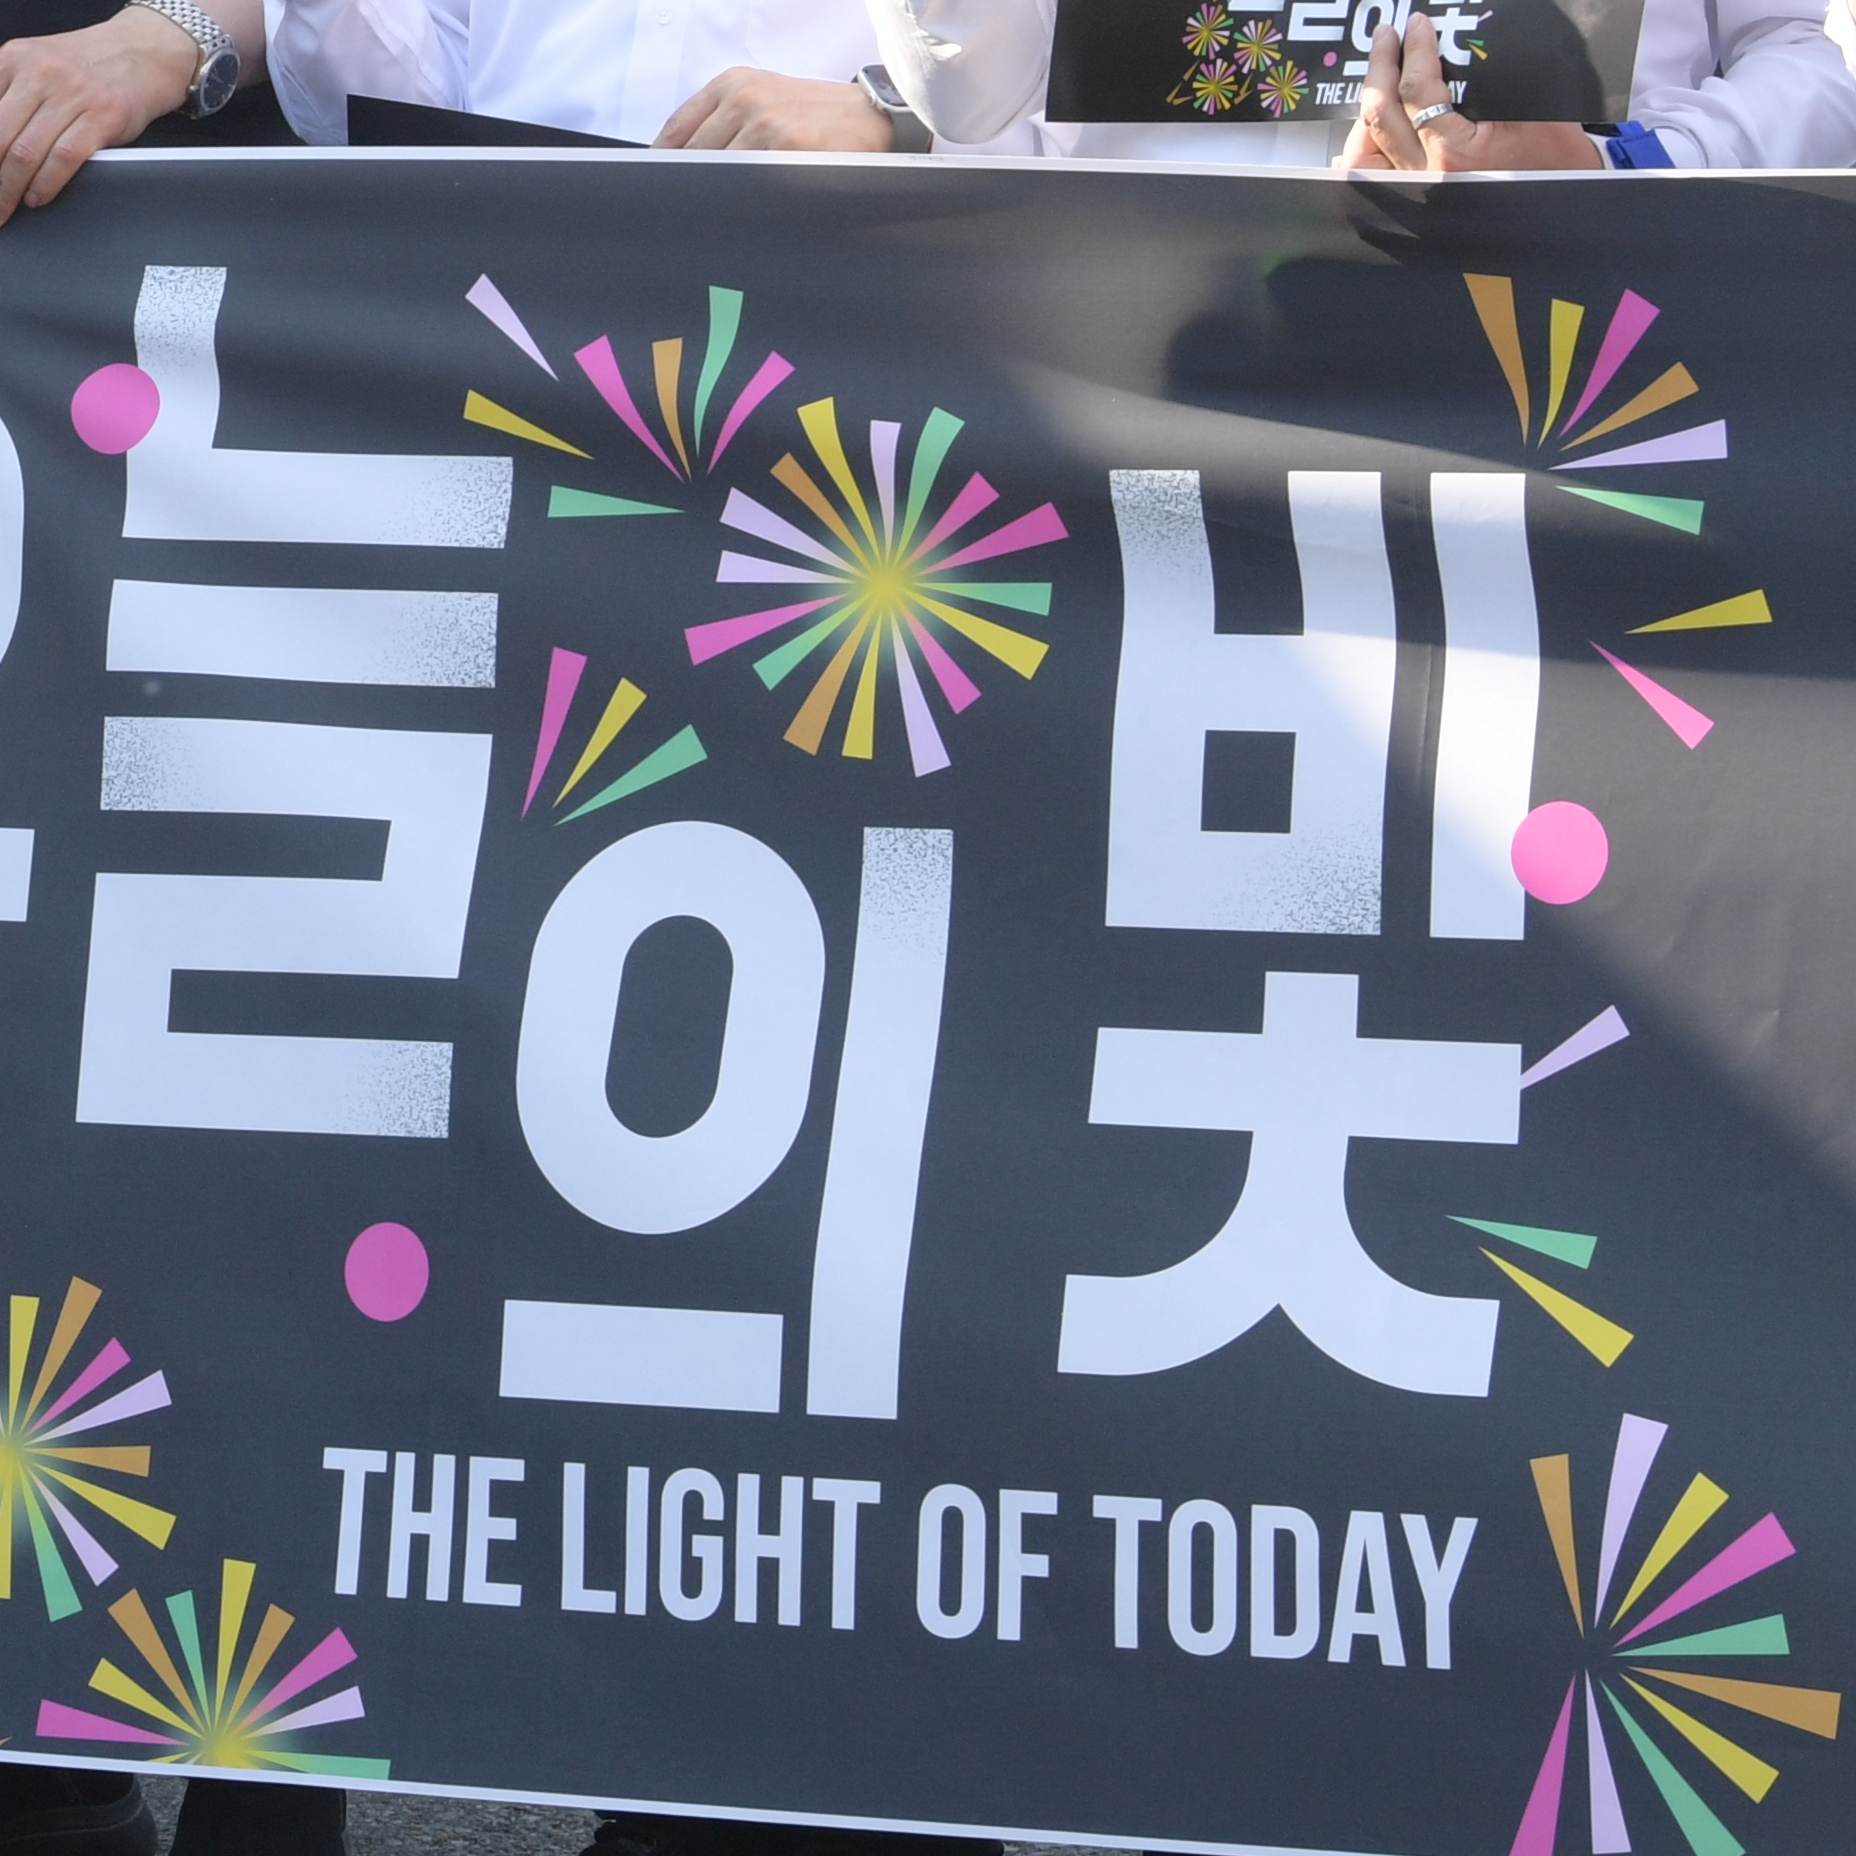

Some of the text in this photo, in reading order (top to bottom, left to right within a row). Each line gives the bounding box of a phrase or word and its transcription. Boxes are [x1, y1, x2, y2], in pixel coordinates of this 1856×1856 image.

[1314, 82, 1348, 106] THE
[1056, 468, 1543, 1398] 빛
[321, 1446, 1480, 1670] THE LIGHT OF TODAY
